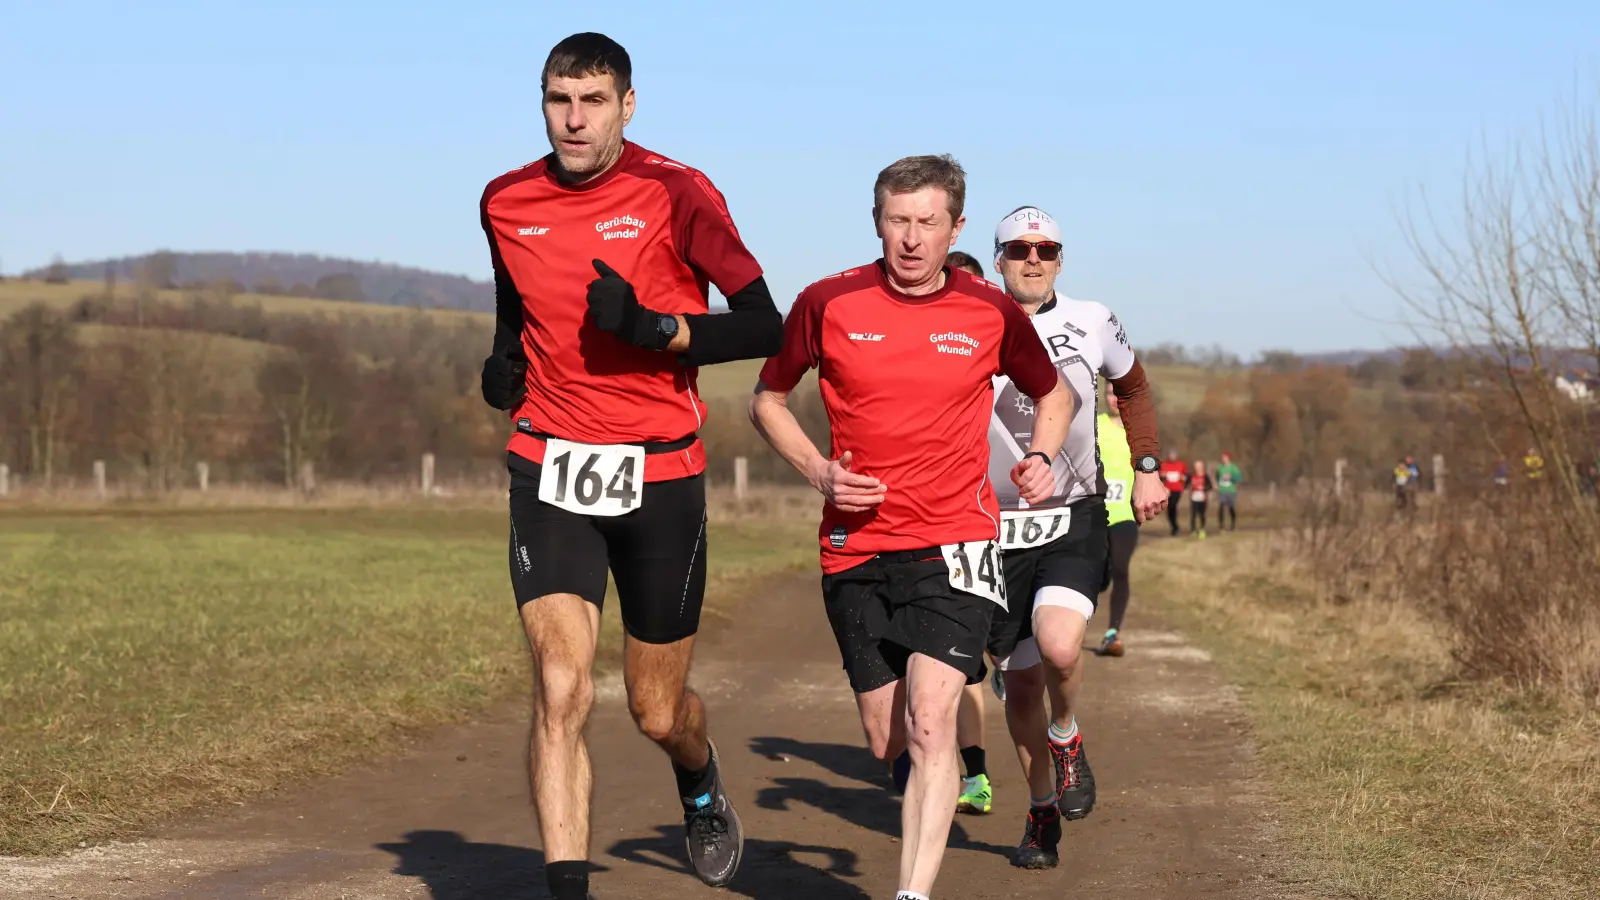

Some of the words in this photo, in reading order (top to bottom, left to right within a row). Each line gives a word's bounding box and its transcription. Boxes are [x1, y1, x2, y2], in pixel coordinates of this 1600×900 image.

[595, 213, 646, 233] Gerüstbau
[602, 228, 638, 241] Wundel
[929, 331, 980, 348] Gerüstbau
[937, 343, 972, 356] Wundel
[552, 450, 637, 508] 164
